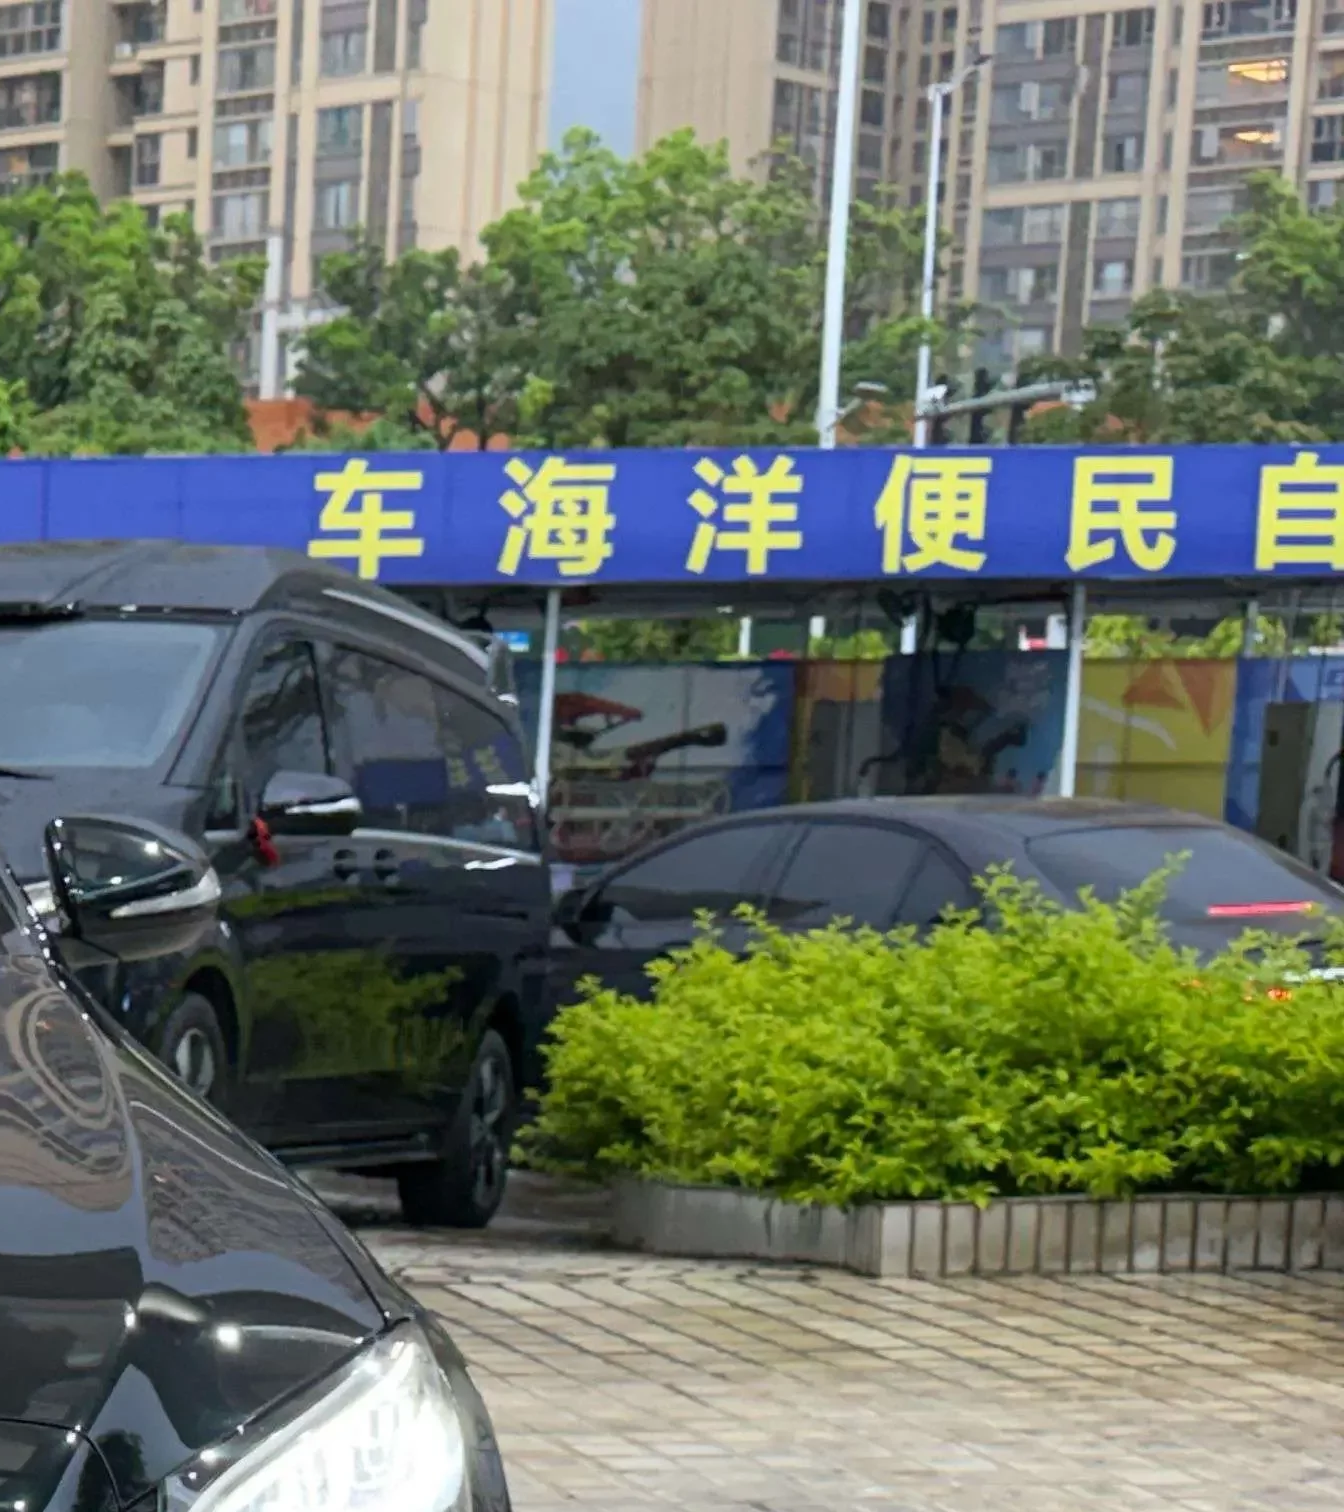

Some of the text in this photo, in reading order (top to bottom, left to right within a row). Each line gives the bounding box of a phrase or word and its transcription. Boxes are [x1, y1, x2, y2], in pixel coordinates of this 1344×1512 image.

[310, 451, 1344, 578] 车海洋便民自
